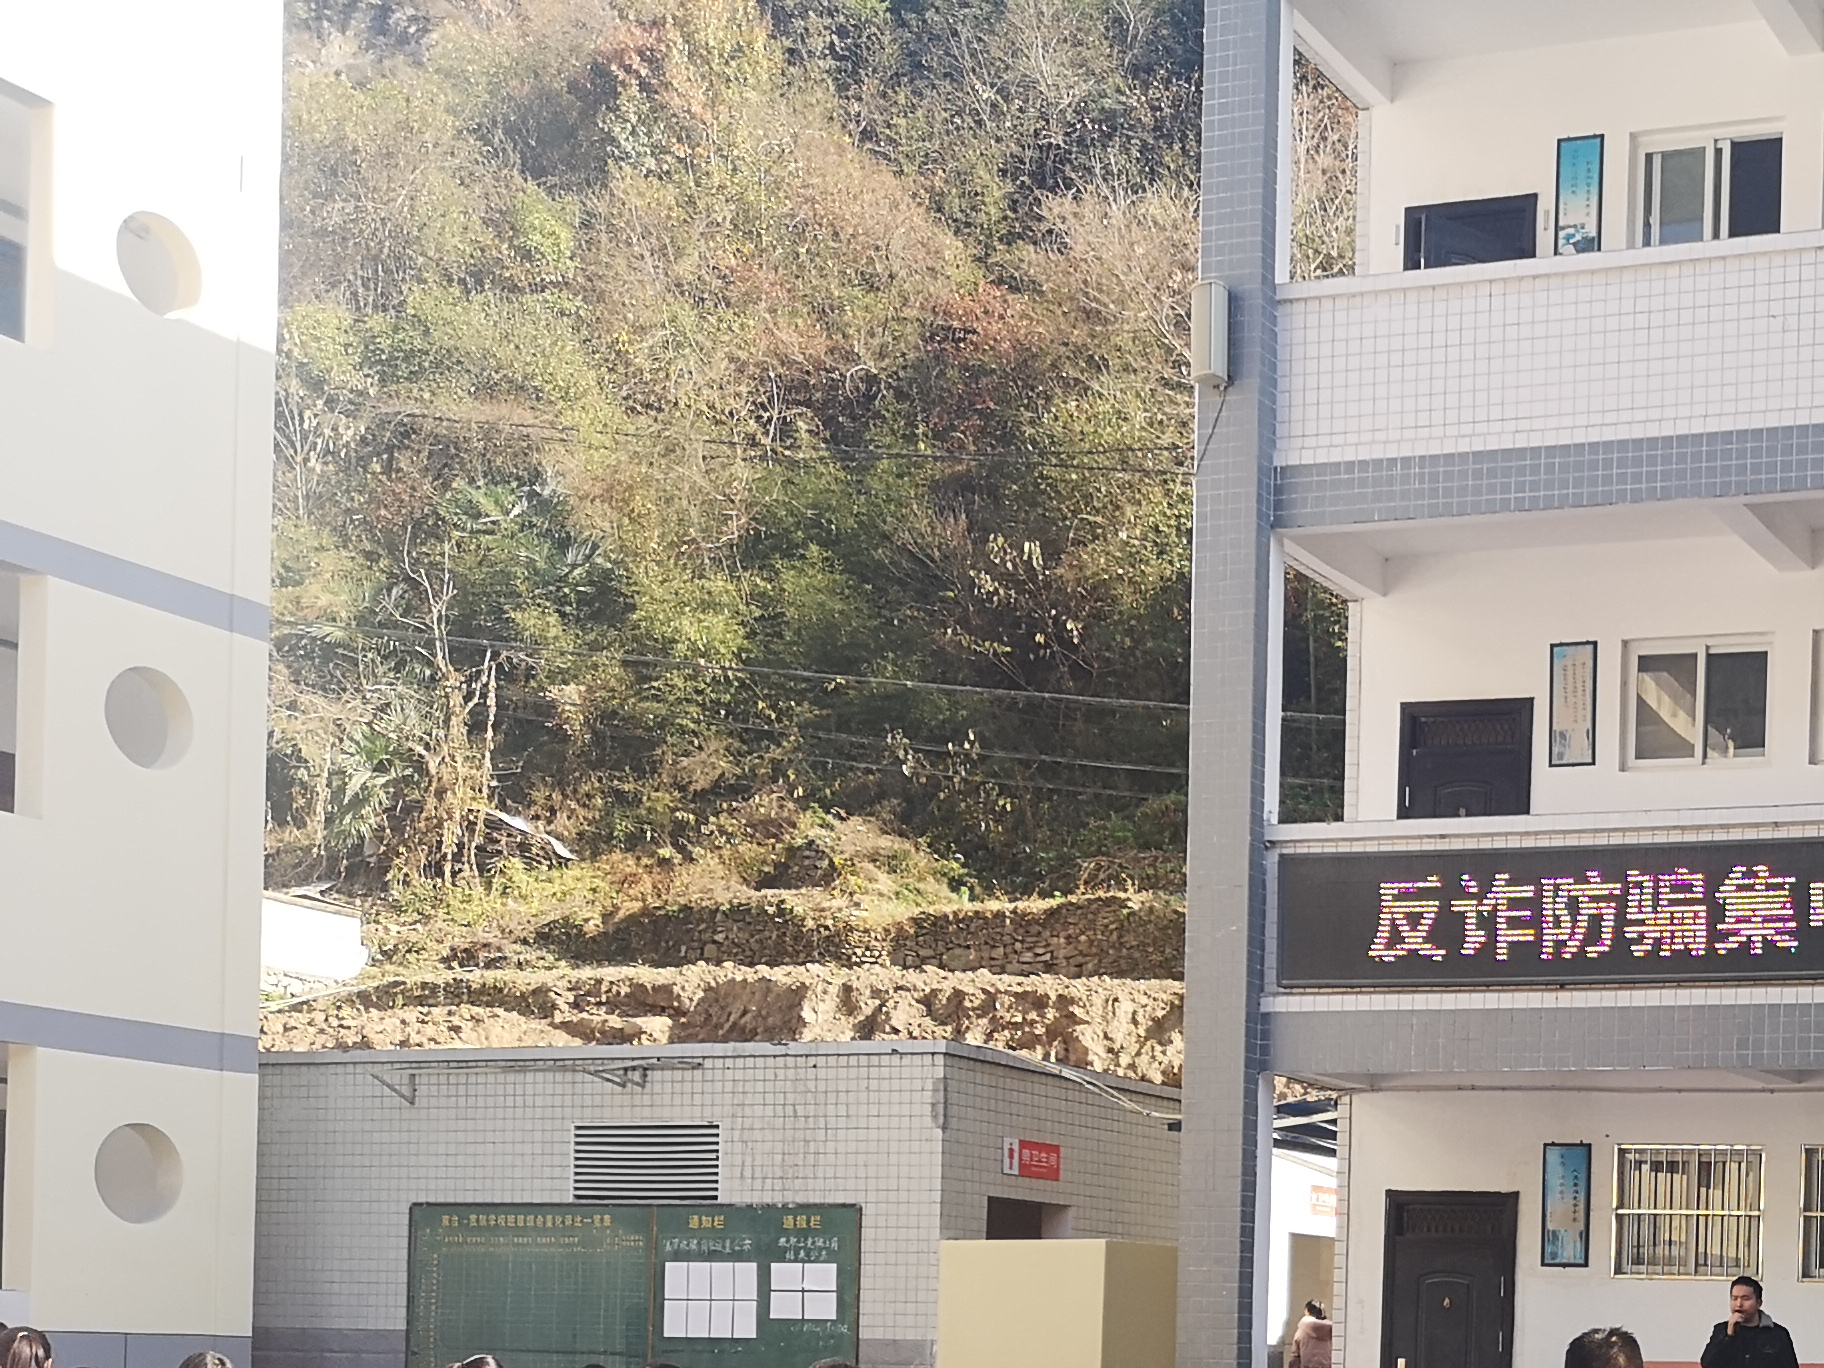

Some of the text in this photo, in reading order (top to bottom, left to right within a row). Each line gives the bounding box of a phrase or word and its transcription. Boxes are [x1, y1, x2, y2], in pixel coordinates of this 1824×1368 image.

[1021, 1149, 1058, 1169] 男卫生间
[688, 1214, 726, 1229] 通知栏
